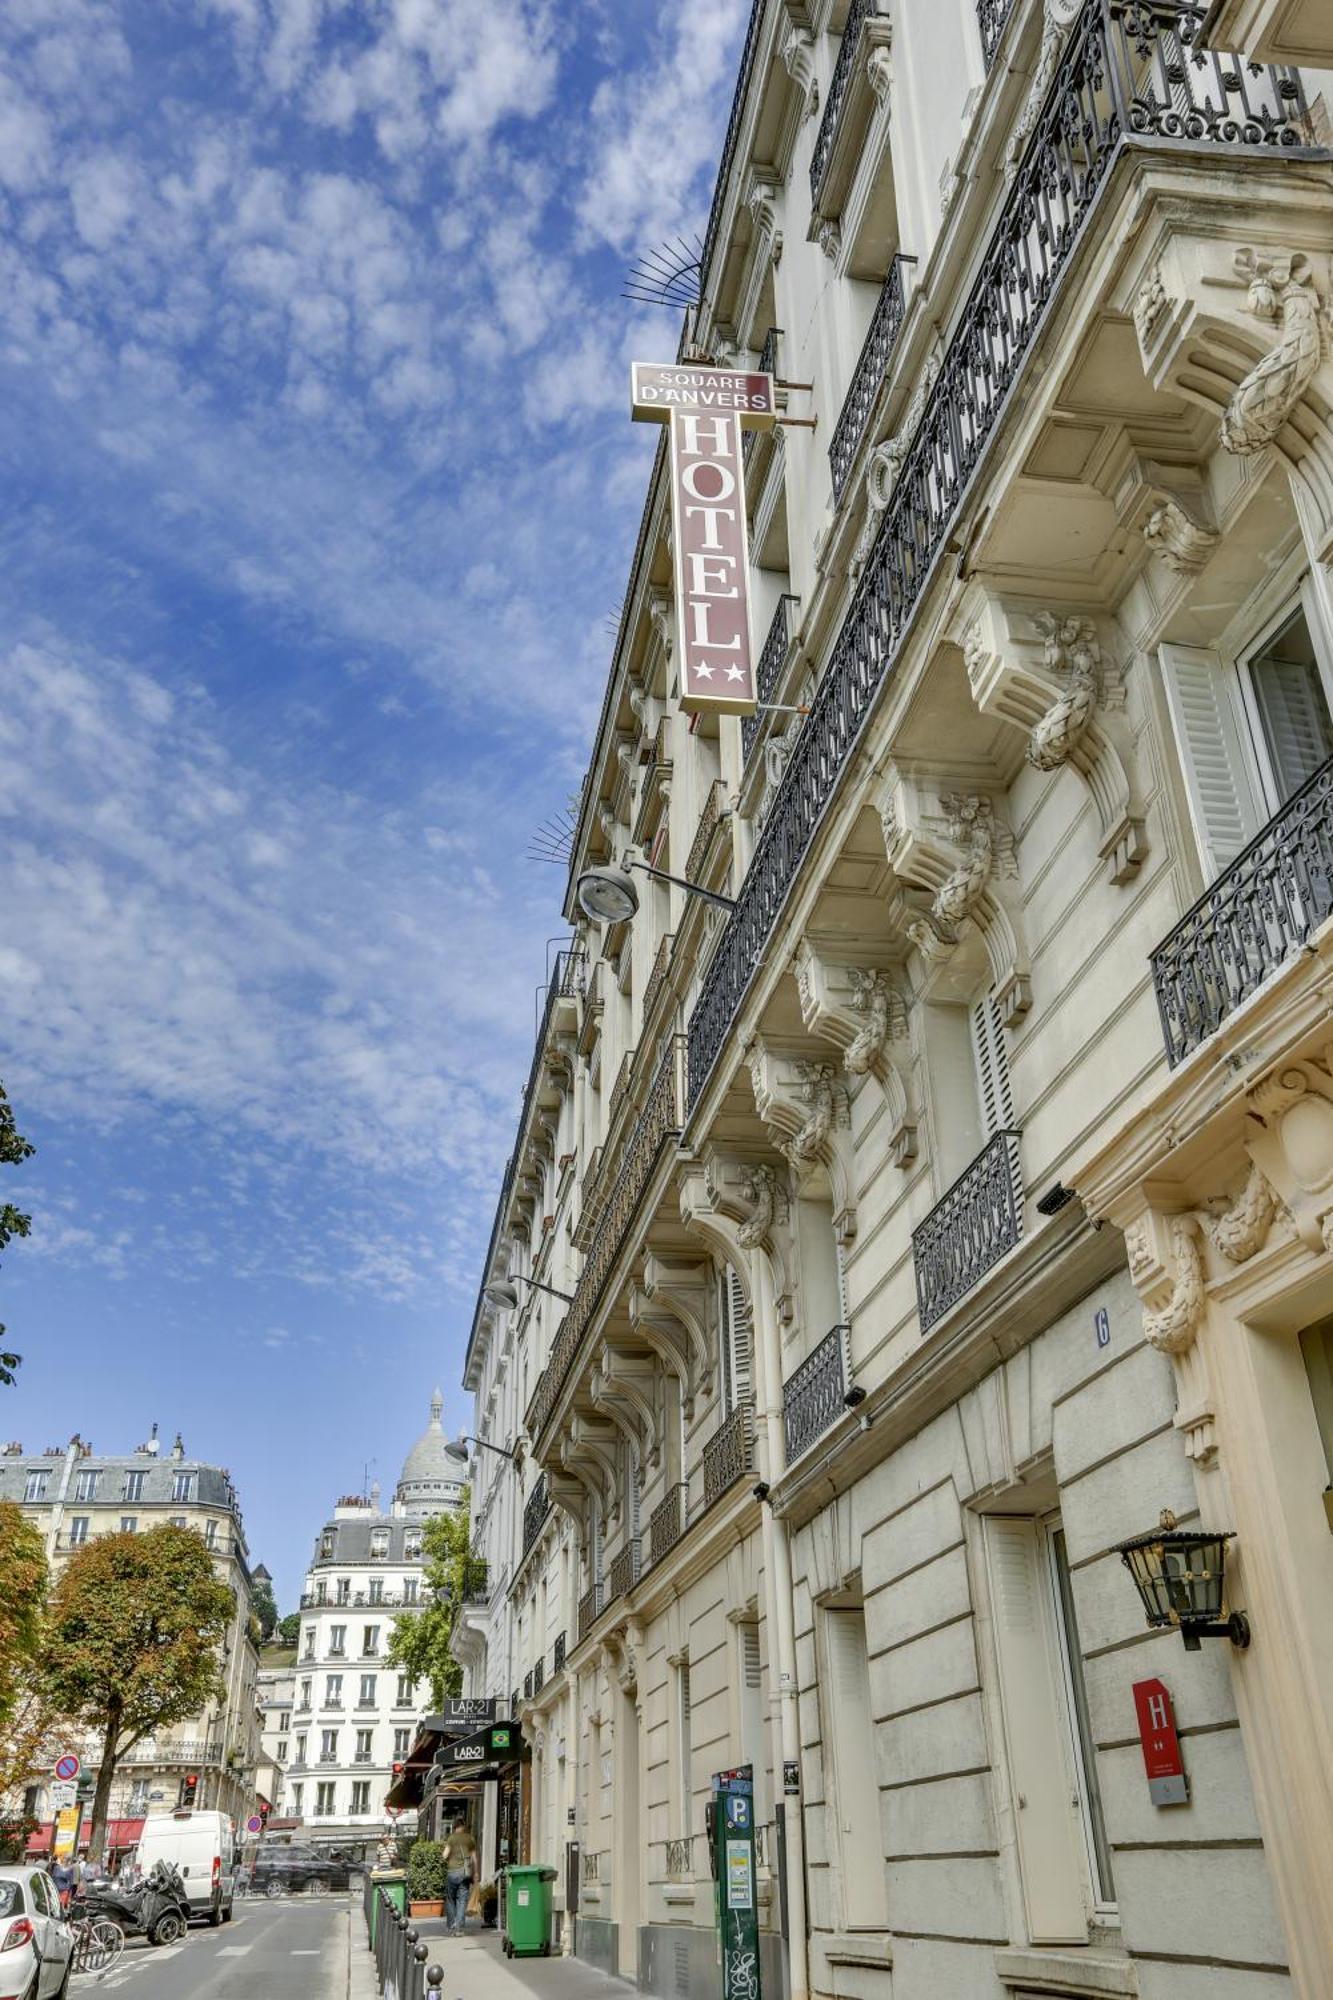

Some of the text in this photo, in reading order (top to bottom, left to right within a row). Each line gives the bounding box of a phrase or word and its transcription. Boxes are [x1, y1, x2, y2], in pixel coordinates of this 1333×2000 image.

[660, 372, 748, 390] SQUARE
[641, 386, 768, 409] D'ANVERS
[680, 414, 741, 649] HOTEL
[1098, 1311, 1109, 1343] 6
[1148, 1693, 1169, 1729] H
[732, 1798, 746, 1822] P
